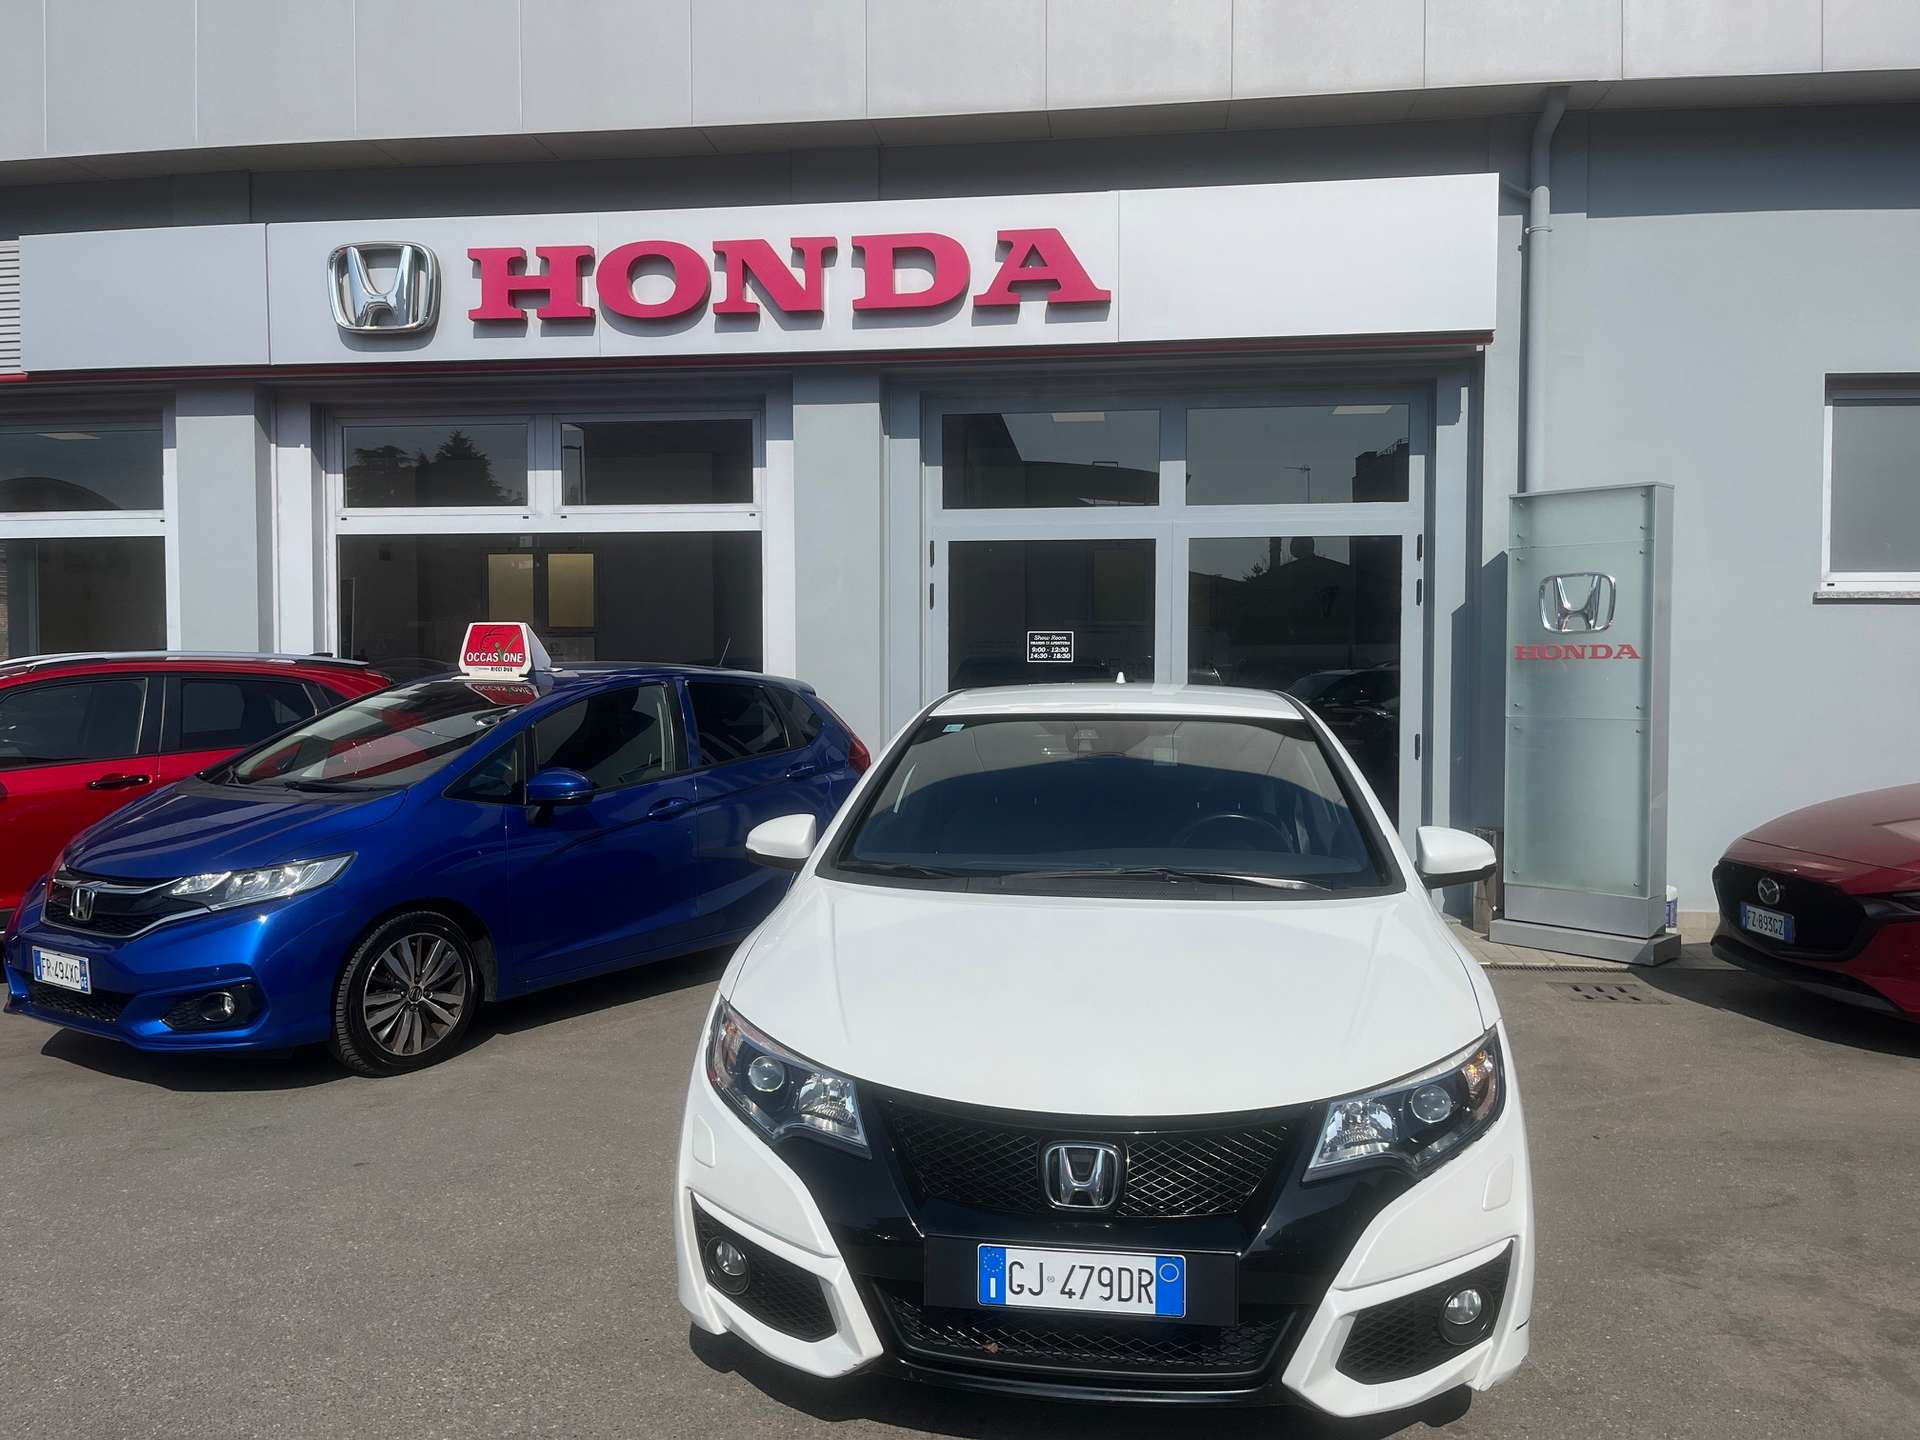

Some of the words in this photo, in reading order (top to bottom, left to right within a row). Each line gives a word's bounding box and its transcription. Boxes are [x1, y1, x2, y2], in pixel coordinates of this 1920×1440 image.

[467, 228, 1111, 322] HONDA
[1514, 644, 1641, 660] HONDA
[1008, 1261, 1044, 1296] GJ
[1060, 1265, 1154, 1304] 479DR
